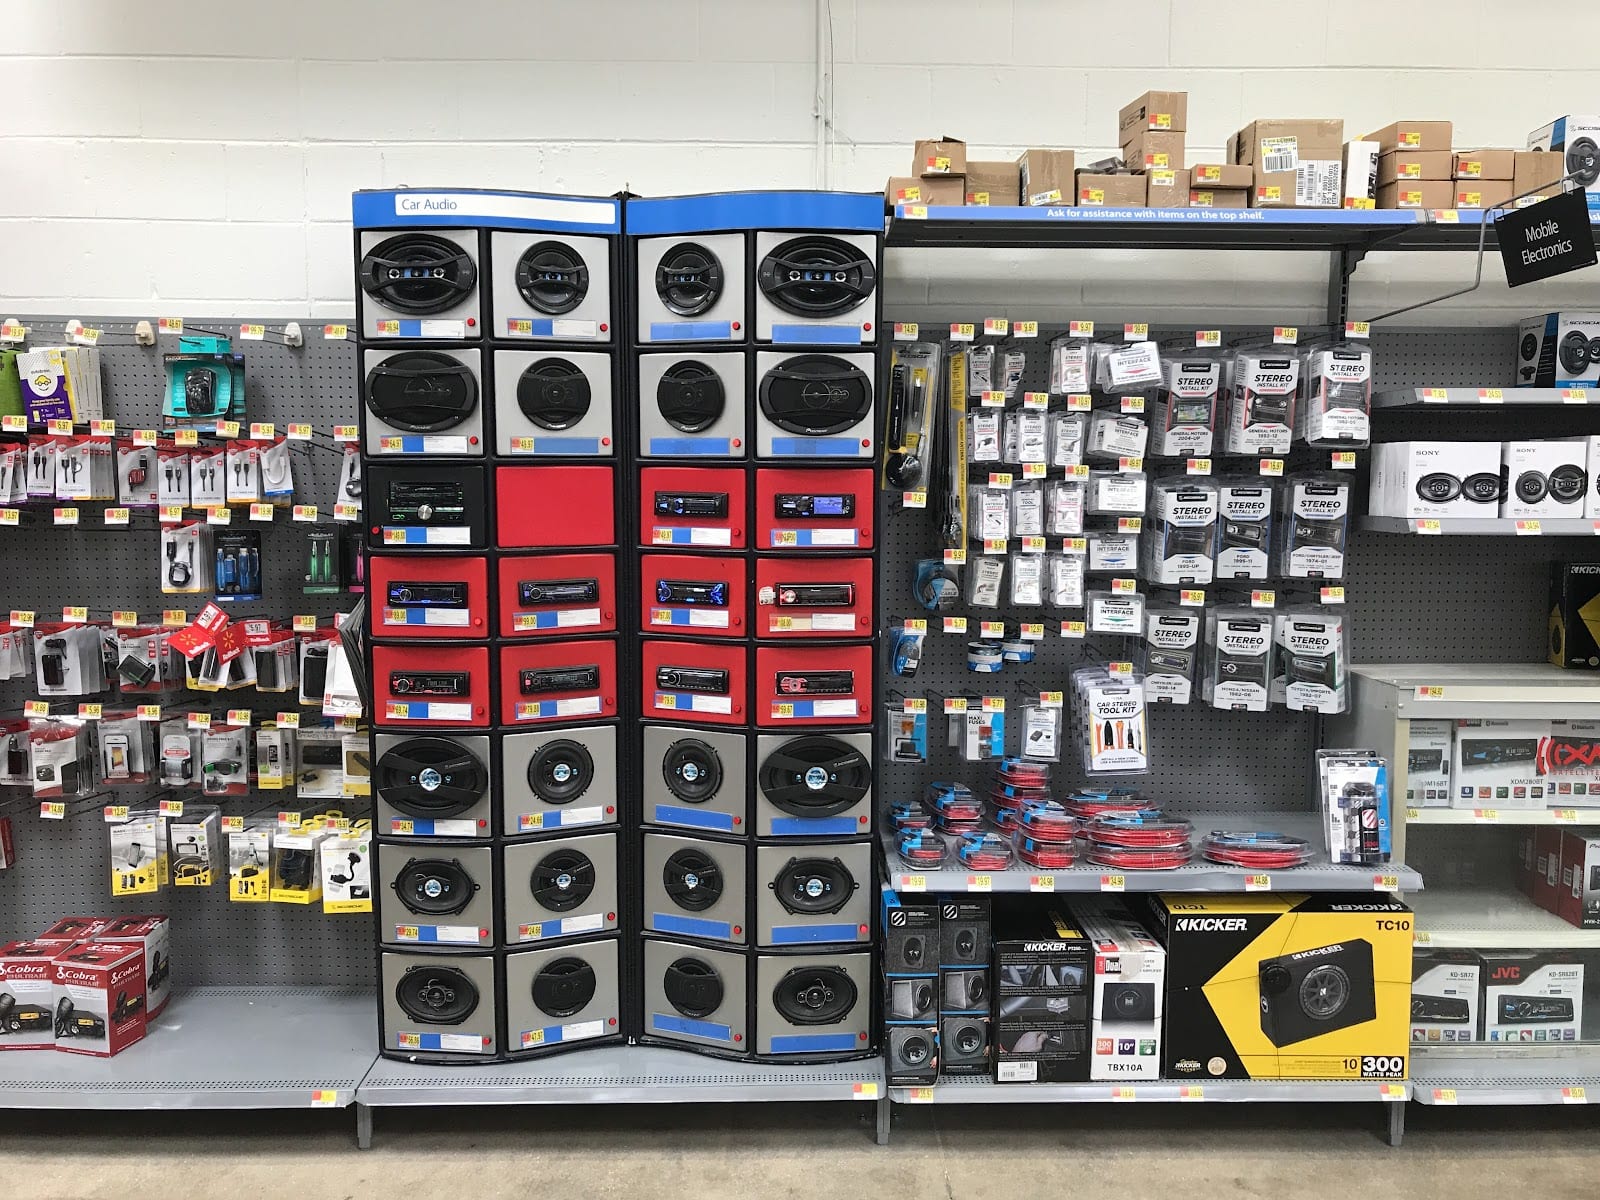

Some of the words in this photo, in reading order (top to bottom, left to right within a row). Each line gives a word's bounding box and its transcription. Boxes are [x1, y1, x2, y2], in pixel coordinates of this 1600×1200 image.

[401, 198, 420, 211] Car
[424, 198, 457, 211] Audio
[1047, 209, 1064, 218] Ask
[1066, 209, 1081, 218] for
[1083, 210, 1132, 218] assistance
[1134, 210, 1156, 219] with
[1157, 210, 1184, 219] items
[1201, 211, 1217, 219] the
[1219, 211, 1236, 221] top
[1238, 210, 1265, 220] shelf.
[1525, 220, 1559, 243] Mobile
[1521, 238, 1573, 265] Electronics
[1116, 356, 1152, 367] INTERFACE
[1329, 364, 1365, 373] STEREO
[1176, 377, 1213, 386] STEREO
[1254, 374, 1293, 382] STEREO
[1114, 428, 1139, 438] INTERFACE
[1226, 501, 1265, 510] STEREO
[1300, 500, 1341, 509] STEREO
[1172, 507, 1212, 515] STEREO
[1154, 630, 1192, 638] STEREO
[1223, 635, 1264, 644] STEREO
[1290, 636, 1329, 645] STEREO
[1112, 700, 1137, 708] STEREO
[1098, 707, 1119, 715] TOOL
[1121, 706, 1137, 714] KIT
[1384, 876, 1398, 885] 39.88
[1187, 918, 1247, 931] KICKER
[1375, 920, 1410, 931] TC10
[1031, 942, 1067, 952] KICKER
[1301, 945, 1344, 960] KICKER
[6, 964, 43, 974] Cobra
[117, 964, 141, 979] Cobra
[1491, 967, 1520, 979] JVC
[65, 970, 98, 981] Cobra
[1107, 1064, 1143, 1072] TBX10A
[1362, 1056, 1403, 1072] 300
